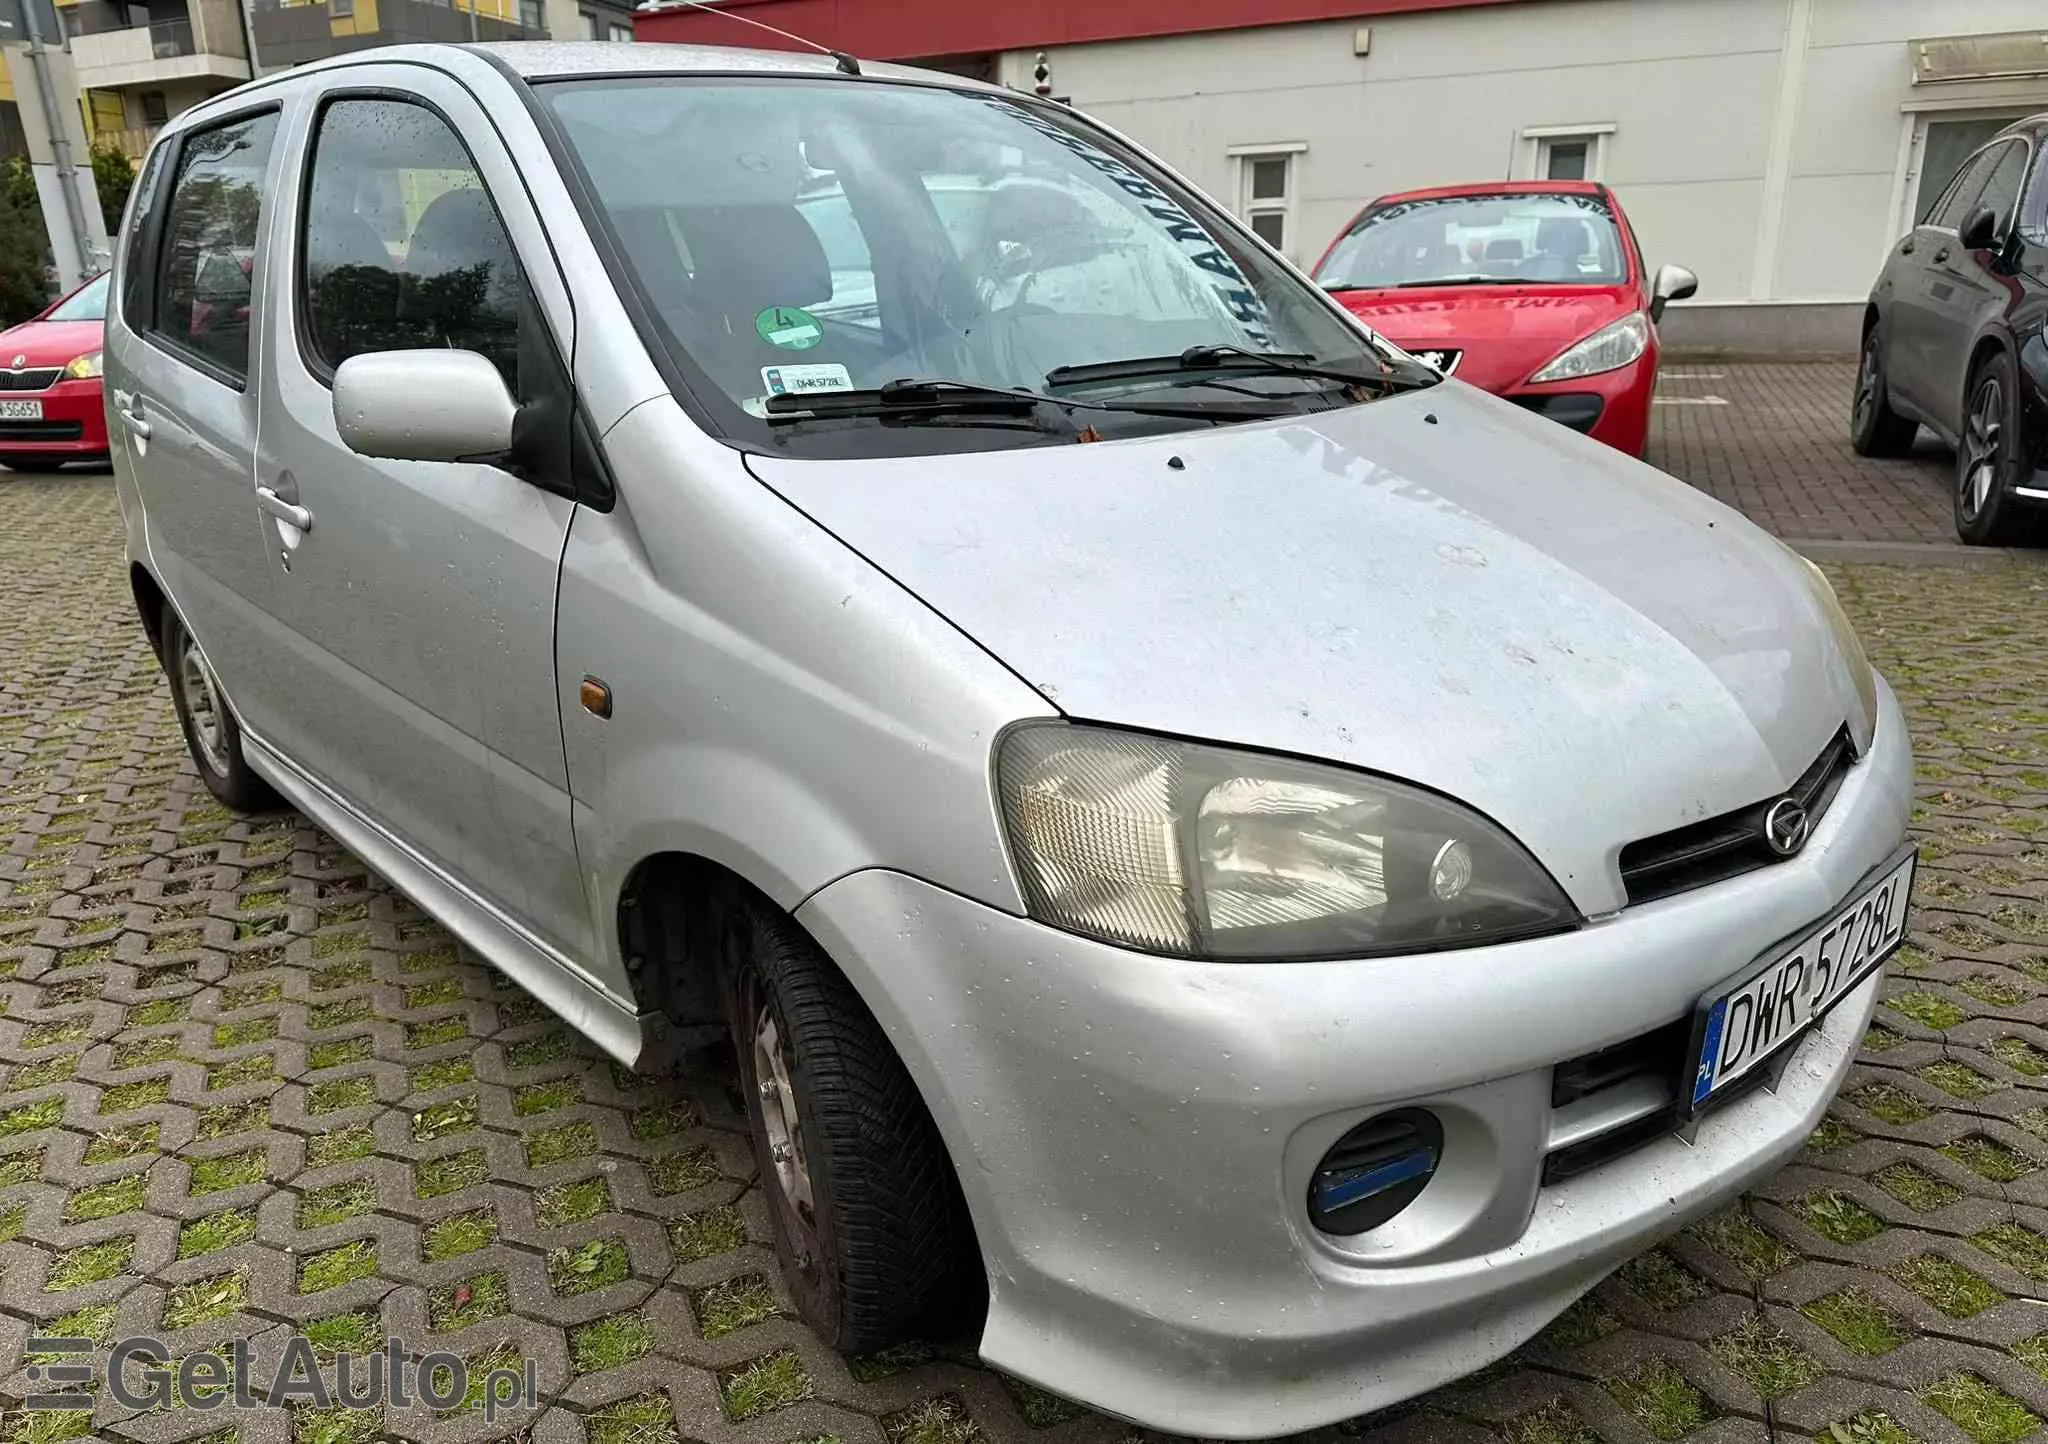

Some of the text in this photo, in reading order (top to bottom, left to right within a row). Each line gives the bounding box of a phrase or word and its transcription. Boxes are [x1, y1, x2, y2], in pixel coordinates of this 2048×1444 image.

[775, 309, 795, 327] 4
[1718, 877, 1898, 1077] DWR 5728L
[1697, 1062, 1711, 1081] PL
